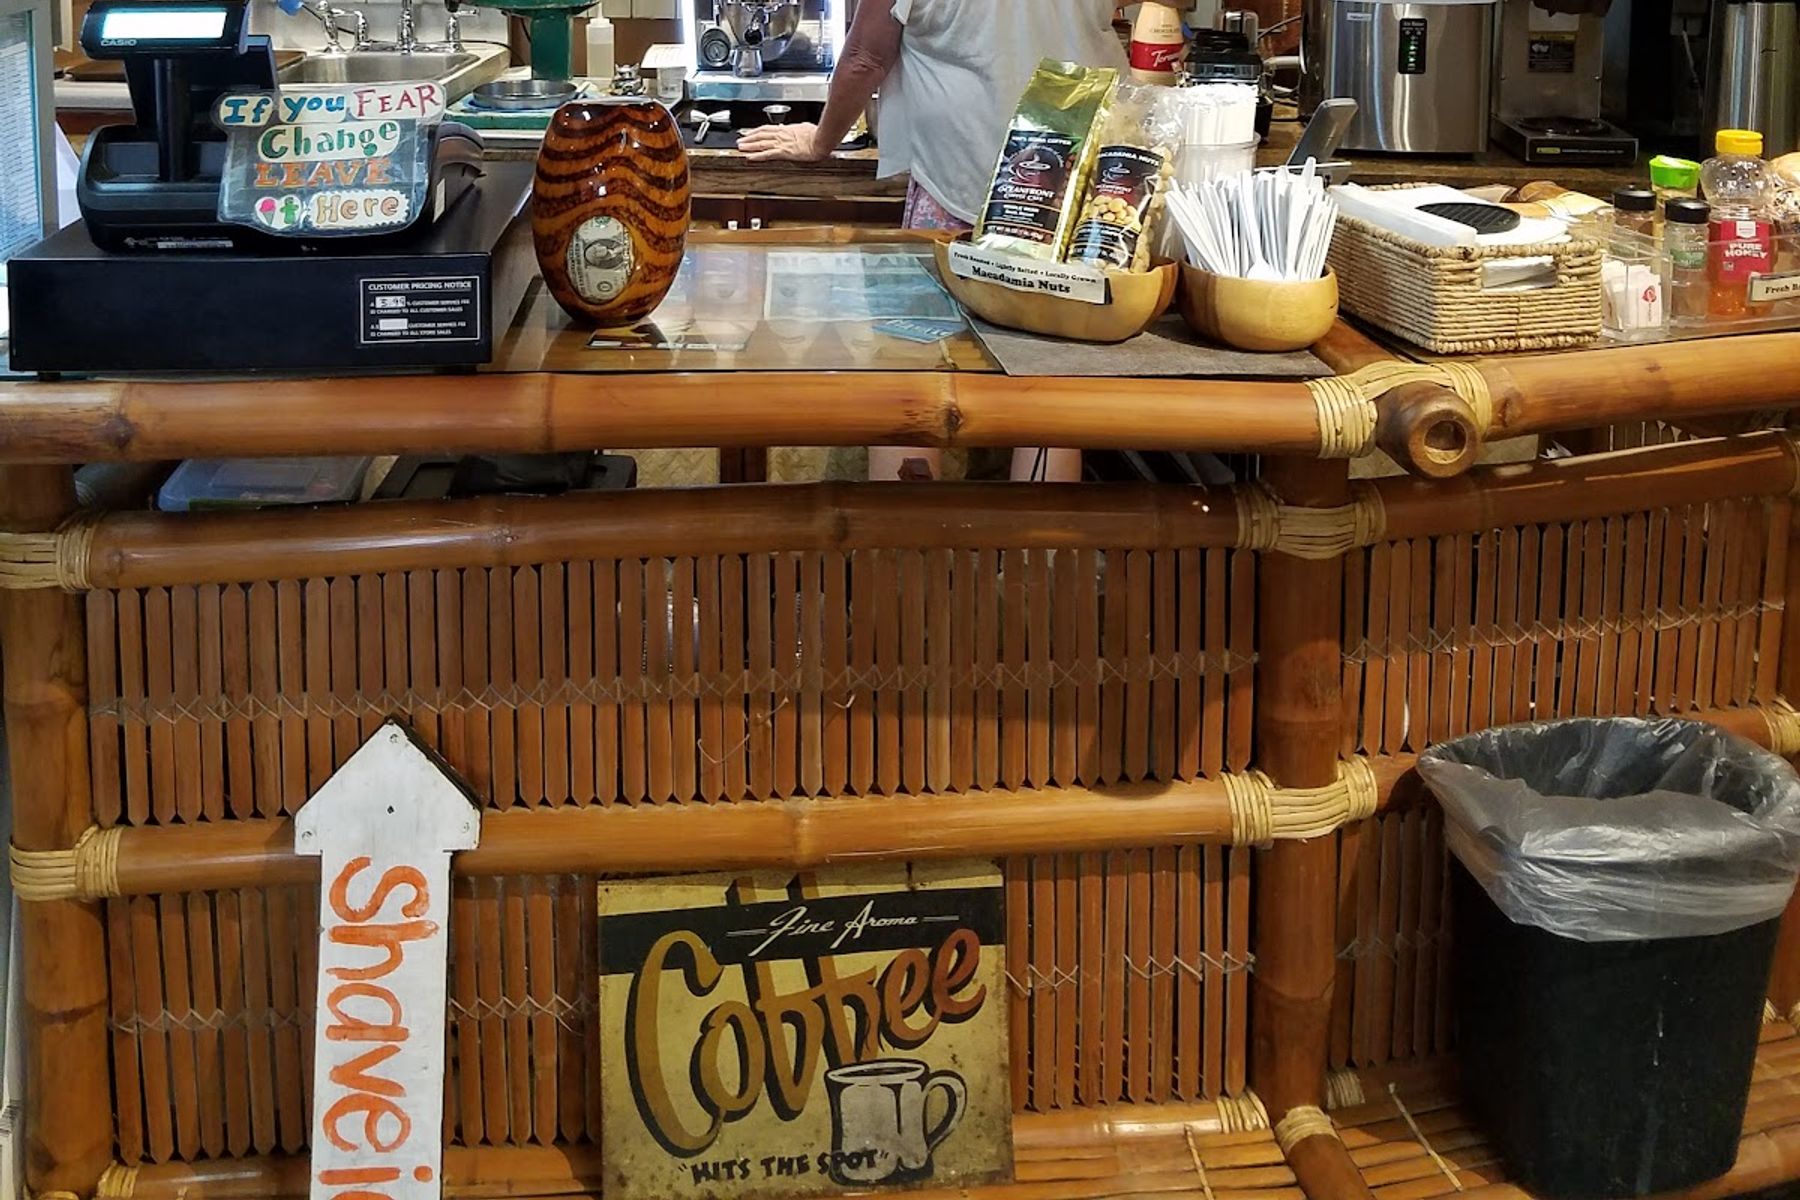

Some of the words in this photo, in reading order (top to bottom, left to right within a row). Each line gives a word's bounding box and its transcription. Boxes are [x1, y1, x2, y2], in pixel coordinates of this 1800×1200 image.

[100, 39, 137, 47] CASIO
[222, 98, 271, 124] If
[283, 95, 344, 122] you
[353, 84, 440, 117] FEAR
[261, 121, 398, 158] Change
[254, 158, 391, 189] LEAVE
[316, 195, 399, 224] Here
[1725, 250, 1768, 259] HONEY
[1729, 243, 1762, 251] PURE
[368, 281, 410, 291] CUSTOMER
[444, 280, 472, 289] NOTICE
[972, 265, 1034, 288] Macadamia
[1039, 279, 1071, 293] Nuts
[749, 906, 834, 956] Fine
[831, 900, 918, 949] Aroma
[322, 856, 440, 1154] Shave
[625, 878, 987, 1158] Coffee
[761, 1155, 809, 1177] THE
